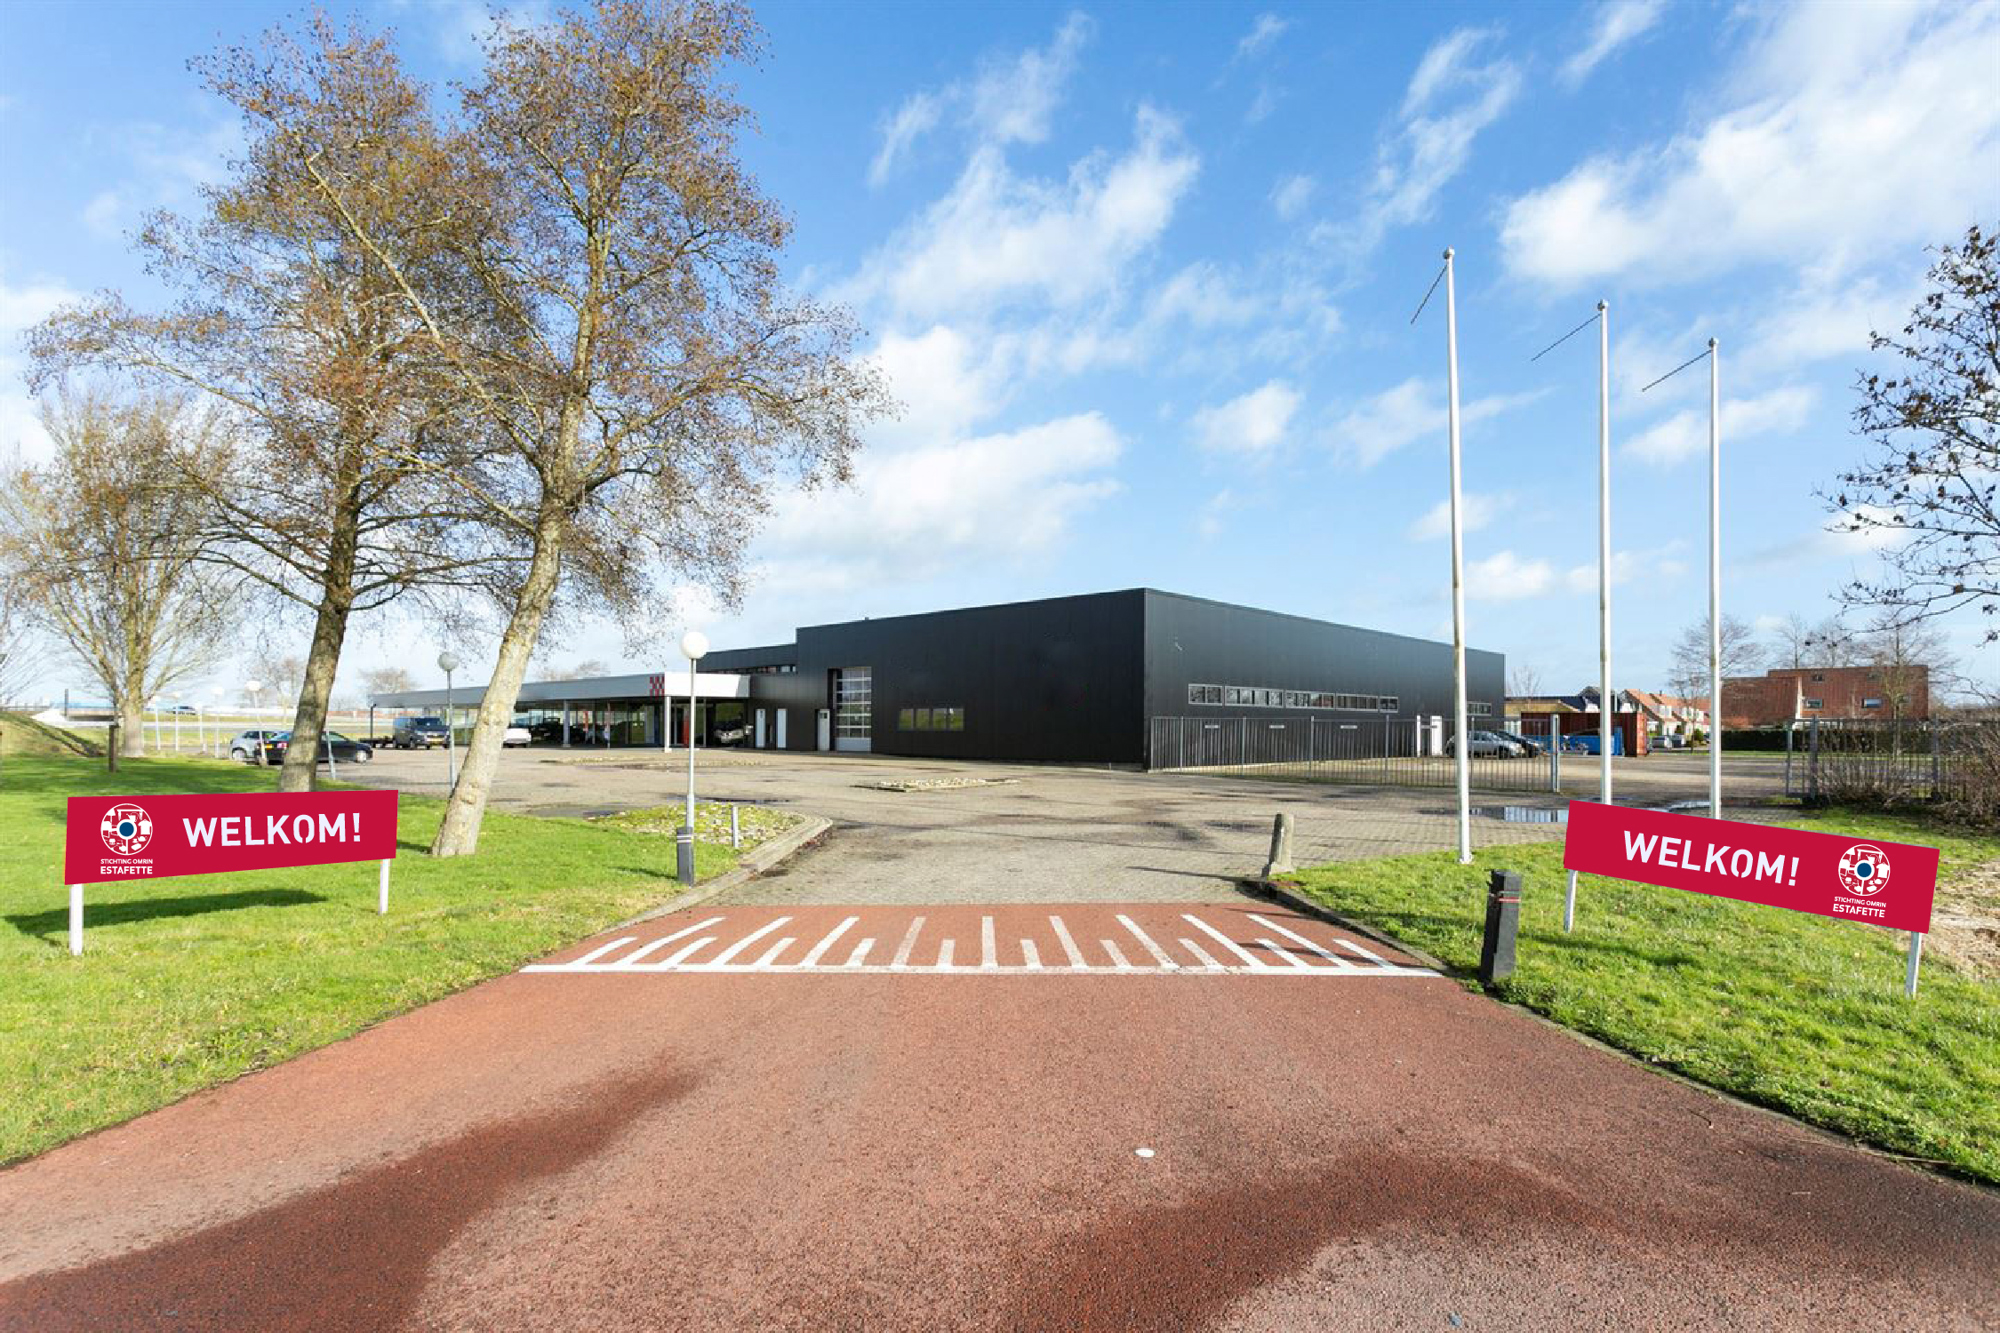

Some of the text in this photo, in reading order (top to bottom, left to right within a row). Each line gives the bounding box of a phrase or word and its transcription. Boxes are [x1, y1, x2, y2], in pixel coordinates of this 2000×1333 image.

[182, 812, 361, 848] WELKOM!
[1623, 830, 1800, 887] WELKOM!
[100, 865, 153, 875] ESTAFETTE
[1834, 896, 1887, 908] STICHTING OMRIN
[1832, 903, 1886, 918] ESTAFETTE
